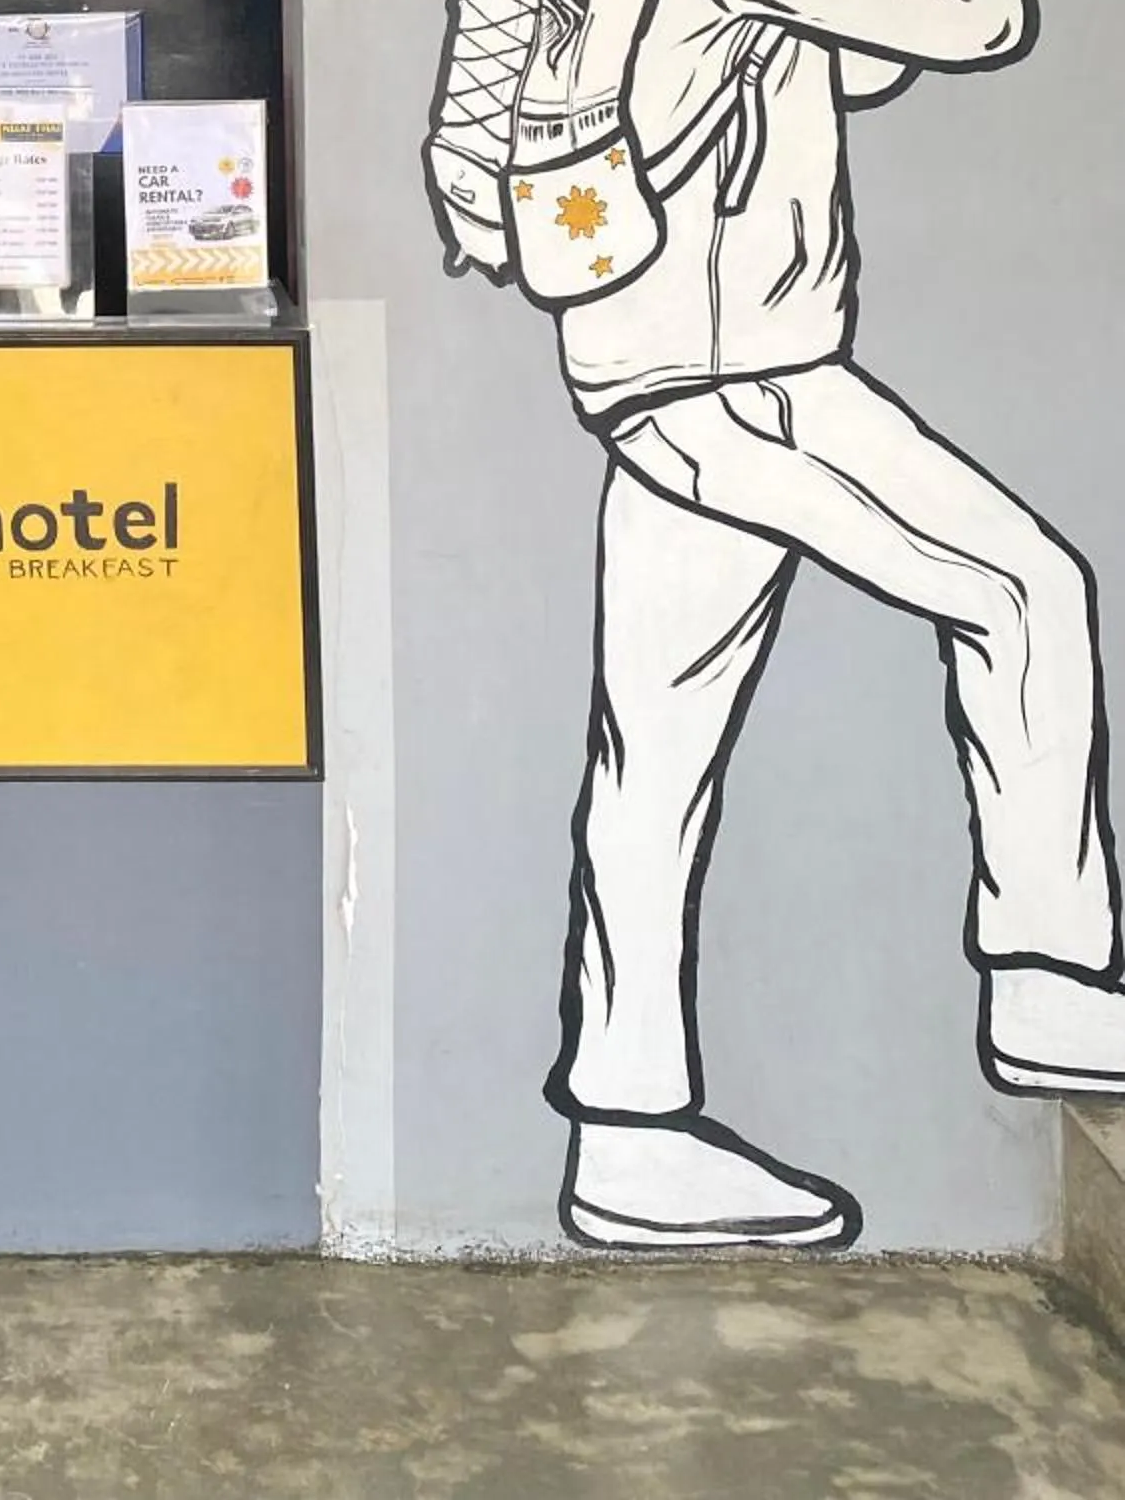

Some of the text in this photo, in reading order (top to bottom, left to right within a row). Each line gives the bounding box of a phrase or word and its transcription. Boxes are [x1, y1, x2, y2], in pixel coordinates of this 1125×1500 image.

[138, 165, 179, 174] NEED A
[138, 175, 170, 188] CAR
[139, 189, 203, 203] RENTAL?
[9, 559, 179, 580] BREAKFAST
